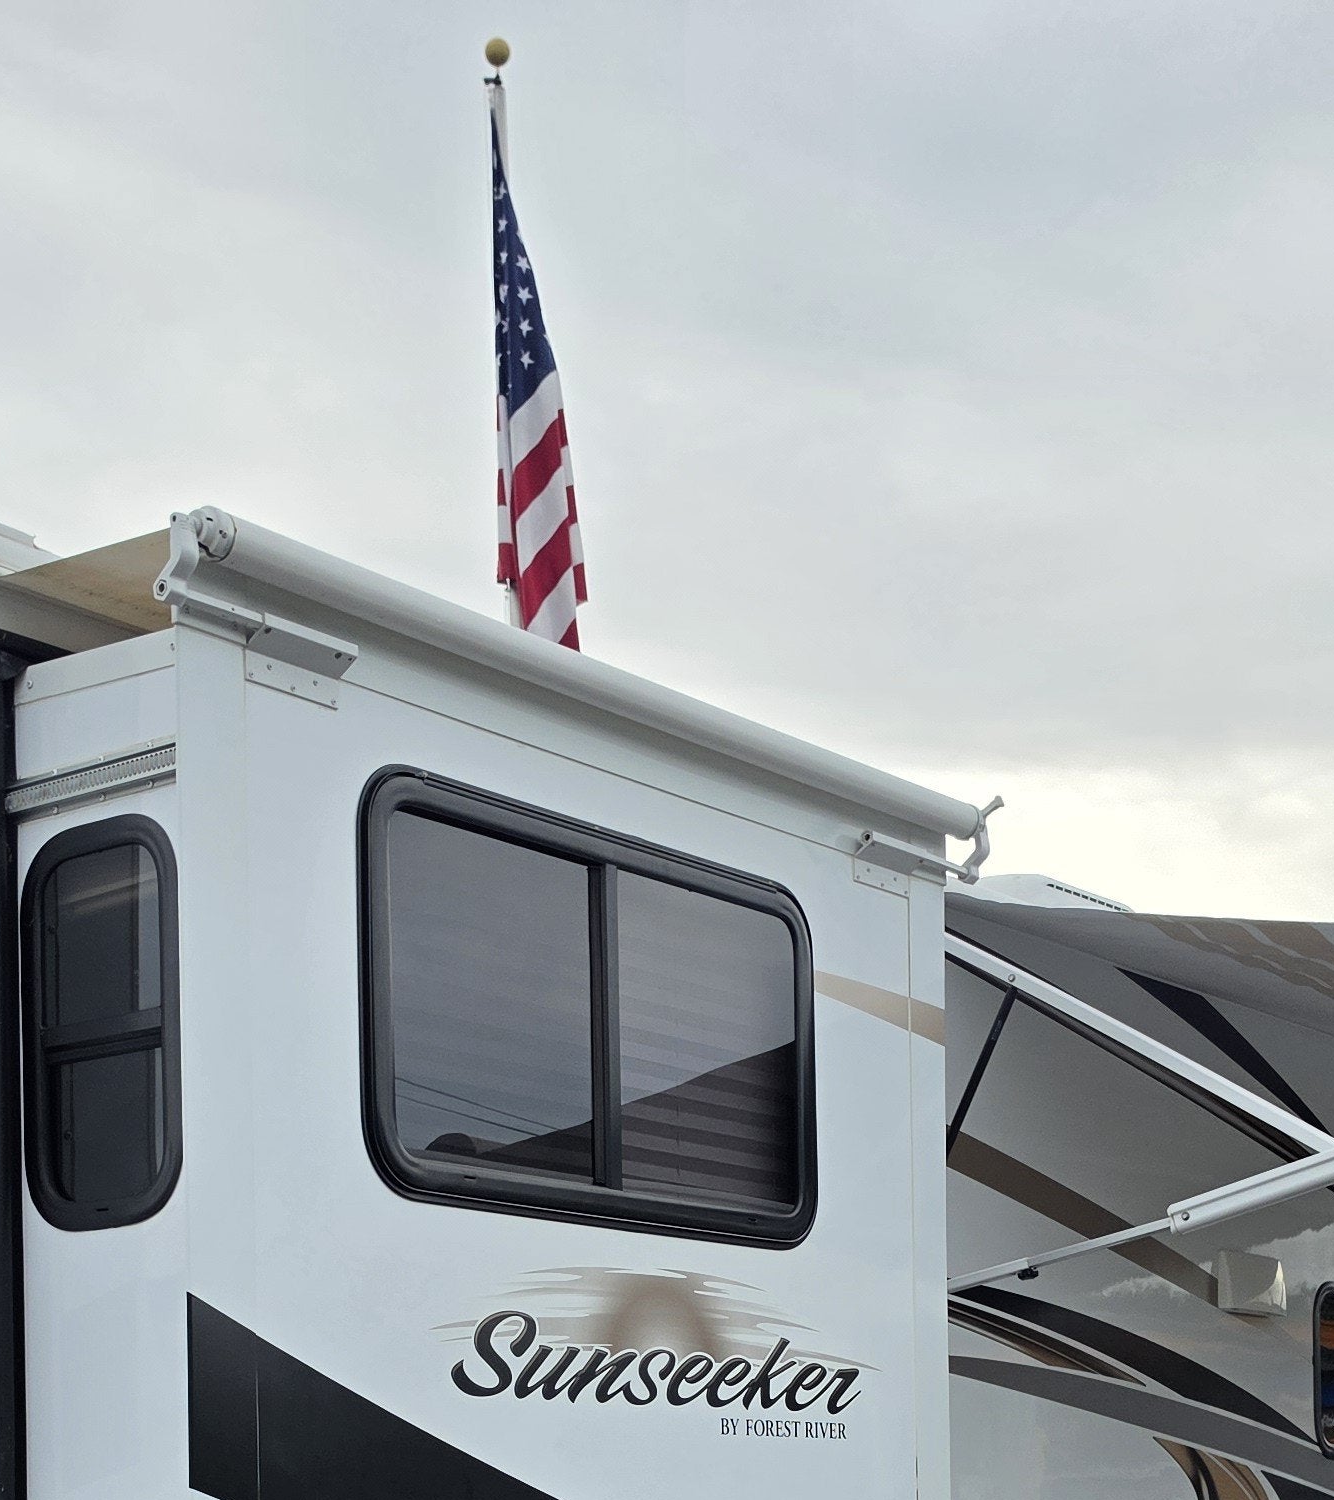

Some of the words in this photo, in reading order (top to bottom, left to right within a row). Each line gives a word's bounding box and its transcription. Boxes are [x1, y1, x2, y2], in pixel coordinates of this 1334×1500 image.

[450, 1309, 862, 1415] Sunseeker
[720, 1417, 740, 1436] BY
[745, 1418, 800, 1438] FOREST
[804, 1421, 848, 1440] RIVER
